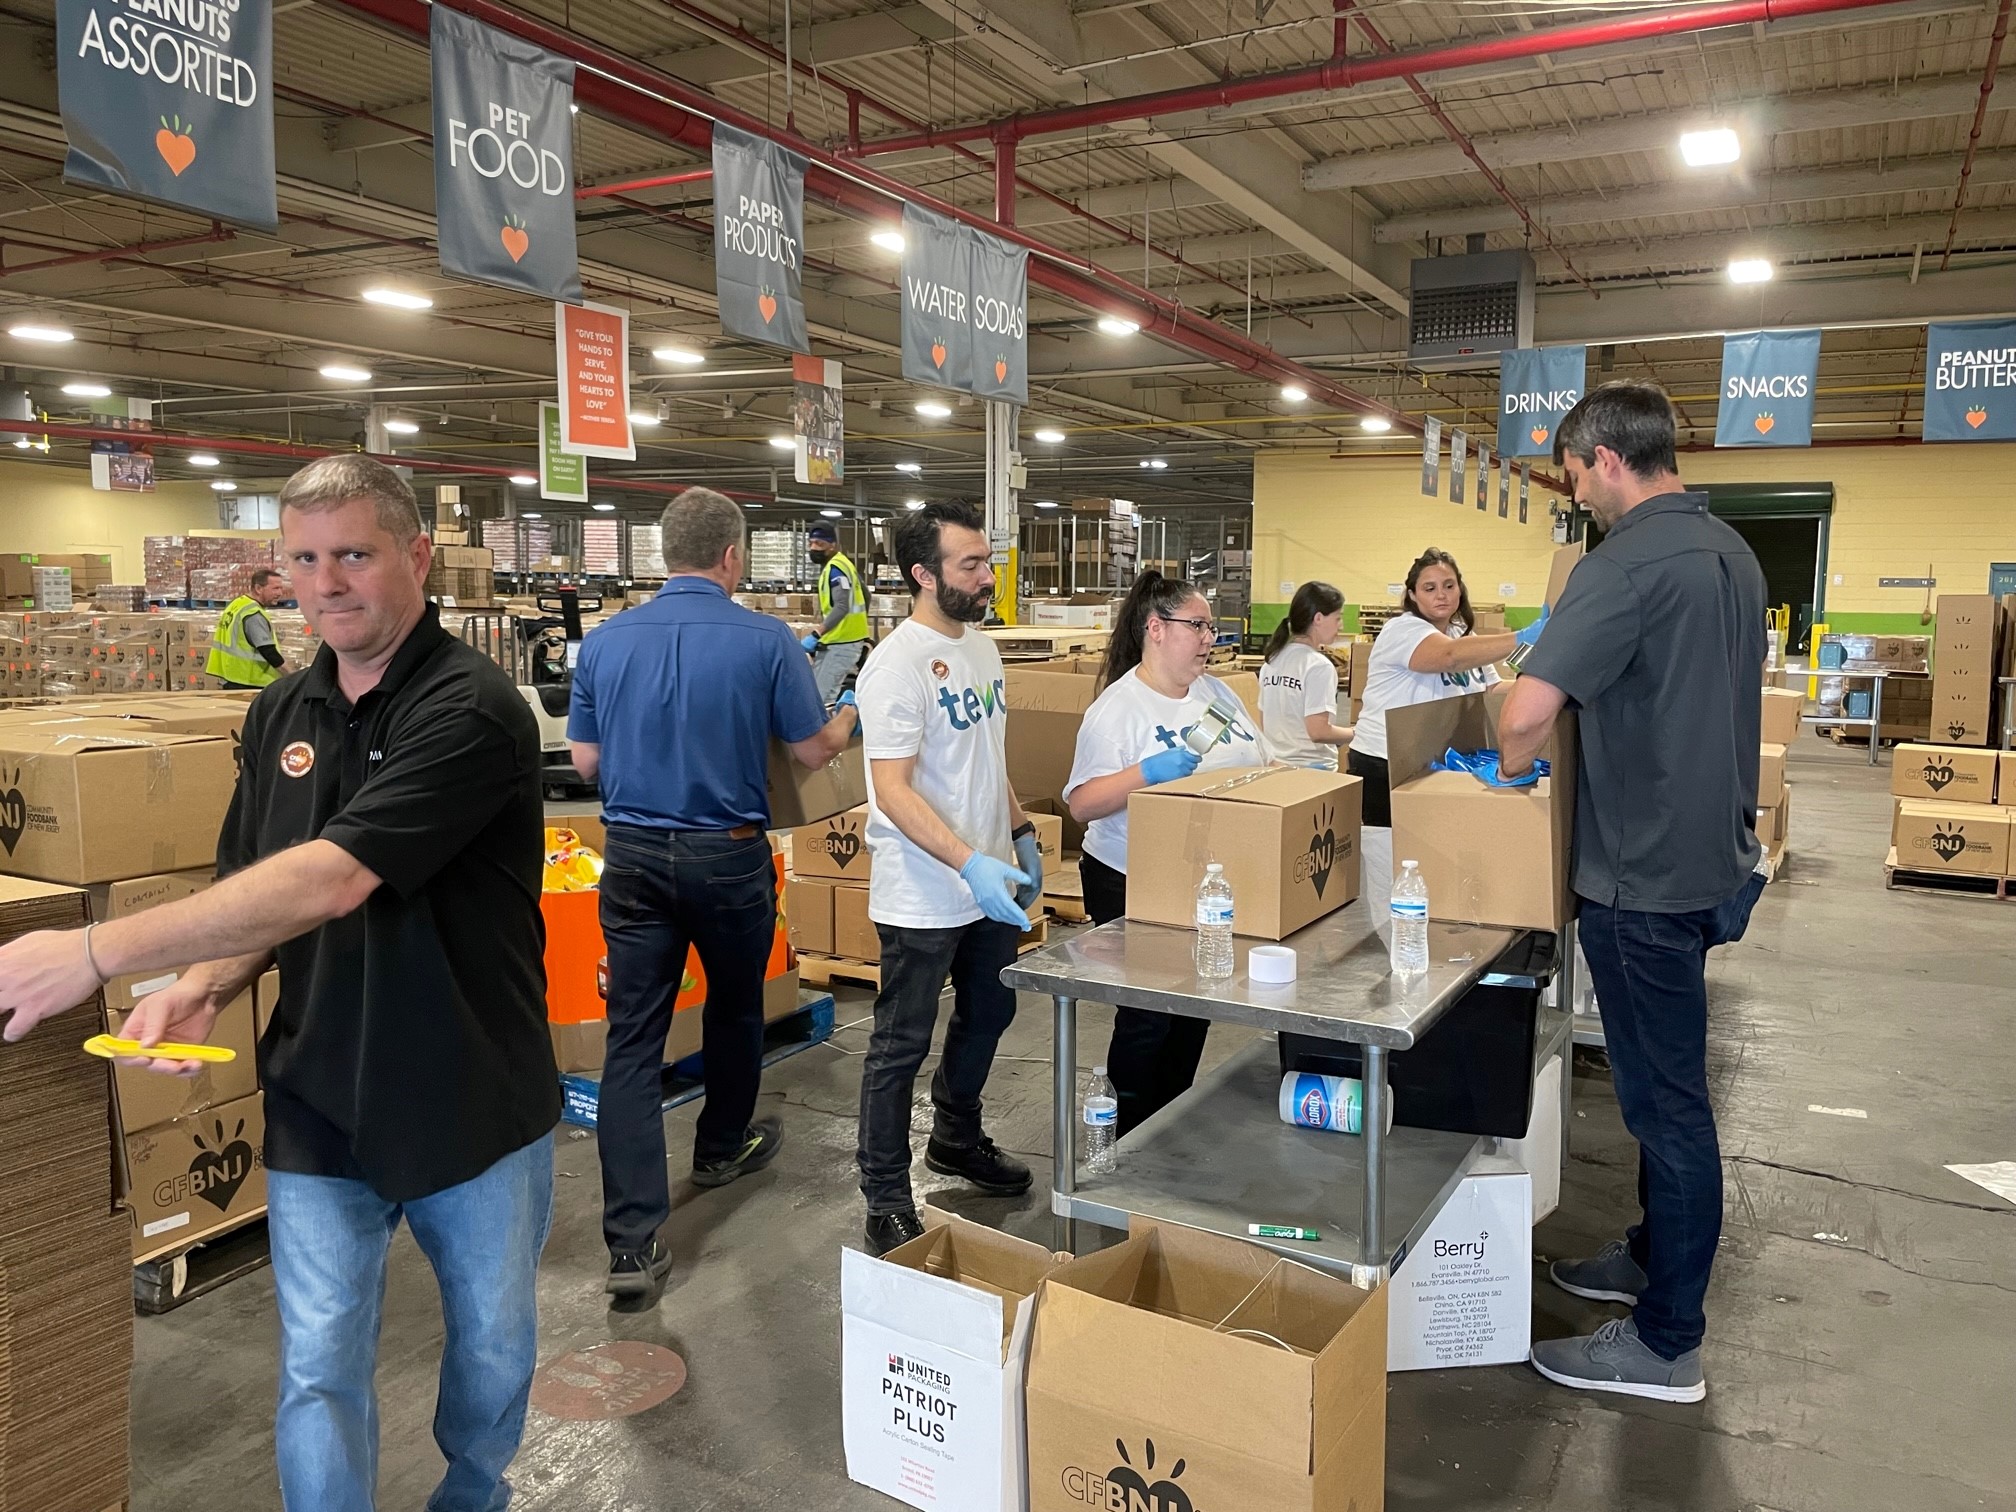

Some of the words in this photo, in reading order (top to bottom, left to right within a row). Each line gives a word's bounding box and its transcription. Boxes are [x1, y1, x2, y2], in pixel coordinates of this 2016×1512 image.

[112, 0, 230, 42] ANUTS
[78, 8, 257, 107] ASSORTED
[489, 101, 531, 139] PET
[449, 118, 566, 196] FOOD
[740, 195, 784, 230] PAPER
[724, 215, 796, 270] PRODUCTS
[907, 275, 967, 324] WATER
[975, 295, 1023, 339] SODAS
[578, 343, 602, 355] HANDS
[603, 348, 613, 357] TO
[595, 332, 614, 344] YOUR
[584, 358, 607, 370] SERVE,
[1940, 348, 2016, 367] PEANUT
[578, 370, 593, 380] AND
[594, 373, 614, 384] YOUR
[1726, 375, 1808, 399] SNACKS
[1935, 363, 2016, 390] BUTTER
[580, 384, 603, 396] HEARTS
[604, 388, 614, 398] TO
[1505, 389, 1578, 414] DRINKS
[1905, 768, 1949, 782] CFBNJ
[26, 813, 58, 825] FOODBANK
[806, 838, 854, 855] CFBNJ
[1912, 836, 1960, 852] CFBNJ
[1293, 842, 1331, 884] CFBNJ
[124, 883, 170, 907] CONTAINS
[1309, 1094, 1320, 1125] CLOROX
[153, 1154, 242, 1208] CFBNJ
[1434, 1240, 1484, 1260] Berry
[908, 1360, 950, 1386] UNITED
[908, 1372, 950, 1394] PACKAGING
[882, 1377, 957, 1421] PATRIOT
[894, 1407, 944, 1443] PLUS
[882, 1428, 900, 1440] Acrylic
[901, 1434, 919, 1446] Carton
[920, 1442, 940, 1457] Sealing
[941, 1450, 954, 1461] Tape
